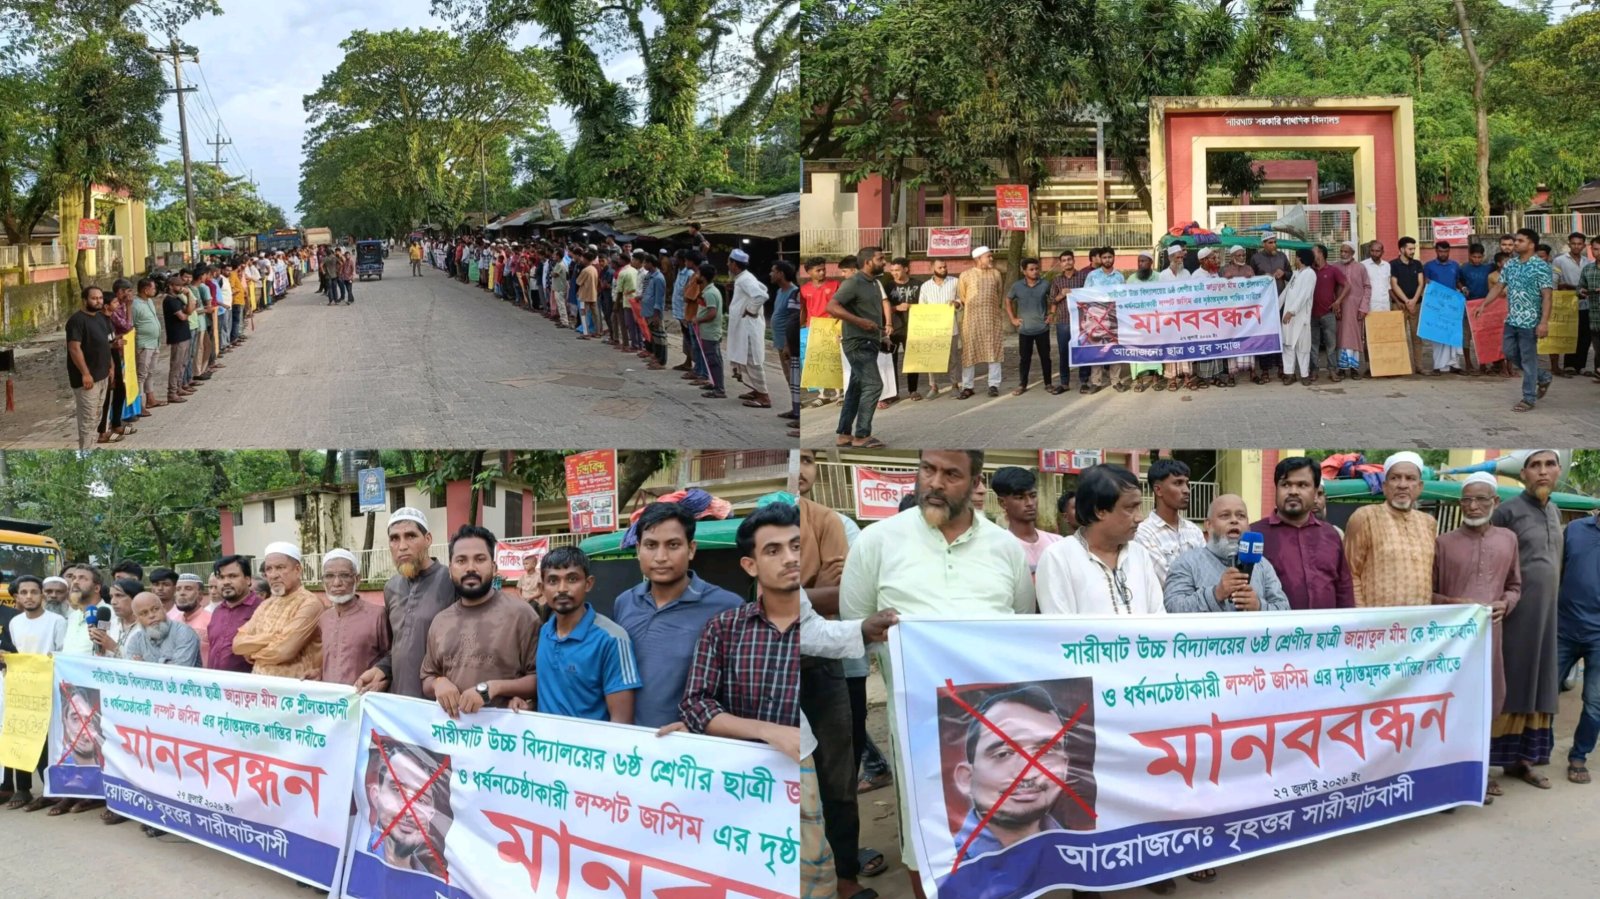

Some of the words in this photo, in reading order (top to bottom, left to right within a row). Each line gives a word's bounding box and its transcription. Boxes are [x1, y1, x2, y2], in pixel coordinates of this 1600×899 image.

[1129, 304, 1263, 334] মানববন্ধন
[1167, 346, 1184, 356] ছাত্র
[1188, 346, 1196, 354] ও
[1198, 344, 1212, 354] যুব
[1216, 341, 1240, 351] সমাজ
[1061, 634, 1131, 665] সারীঘাট
[1136, 634, 1168, 659] উচ্চ
[1173, 632, 1246, 658] বিদ্যালয়ের
[1250, 628, 1272, 654] ৬ষ্ঠ
[1275, 627, 1312, 650] শ্রেণীর
[1316, 625, 1342, 650] ছাত্রী
[1344, 629, 1386, 650] জান্নাতুল
[1389, 622, 1406, 643] মীম
[1410, 627, 1424, 642] কে
[92, 667, 115, 684] সারীঘাট
[116, 671, 128, 686] উচ্চ
[128, 672, 164, 692] বিদ্যালয়ের
[180, 679, 202, 697] শ্রেণীর
[204, 682, 222, 700] ছাত্রী
[224, 688, 258, 710] জান্নাতুল
[260, 688, 278, 710] মীম
[280, 696, 294, 711] কে
[297, 694, 348, 720] শ্লীলতাহানী
[1102, 688, 1116, 708] ও
[1224, 666, 1265, 695] লম্পট
[1270, 664, 1309, 692] জসিম
[1314, 668, 1332, 686] এর
[1394, 656, 1422, 679] শাস্তির
[1426, 652, 1461, 674] দাবীতে
[104, 697, 108, 708] ও
[154, 703, 176, 720] লম্পট
[178, 704, 200, 726] জসিম
[202, 714, 215, 728] এর
[263, 722, 292, 742] শাস্তির
[295, 725, 326, 748] দাবীতে
[1128, 692, 1455, 789] মানববন্ধন
[114, 724, 328, 818] মানববন্ধন
[432, 720, 484, 748] সারীঘাট
[487, 725, 518, 752] উচ্চ
[522, 729, 608, 771] বিদ্যালয়ের
[612, 746, 644, 777] ৬ষ্ঠ
[650, 754, 714, 793] শ্রেণীর
[721, 766, 776, 804] ছাত্রী
[1273, 788, 1290, 800] ২৭
[1292, 779, 1318, 798] জুলাই
[1322, 777, 1349, 791] ২০২৬
[1350, 772, 1361, 784] ইং
[103, 780, 153, 811] য়োজনেঃ
[154, 800, 192, 827] বৃহত্তর
[196, 812, 290, 859] সারীঘাটবাসী
[188, 793, 204, 805] জুলাই
[458, 768, 468, 784] ও
[574, 790, 632, 824] লম্পট
[638, 802, 704, 844] জসিম
[713, 824, 751, 855] এর
[1054, 826, 1215, 873] আয়োজনেঃ
[1224, 809, 1296, 852] বৃহত্তর
[1302, 774, 1415, 825] সারীঘাটবাসী
